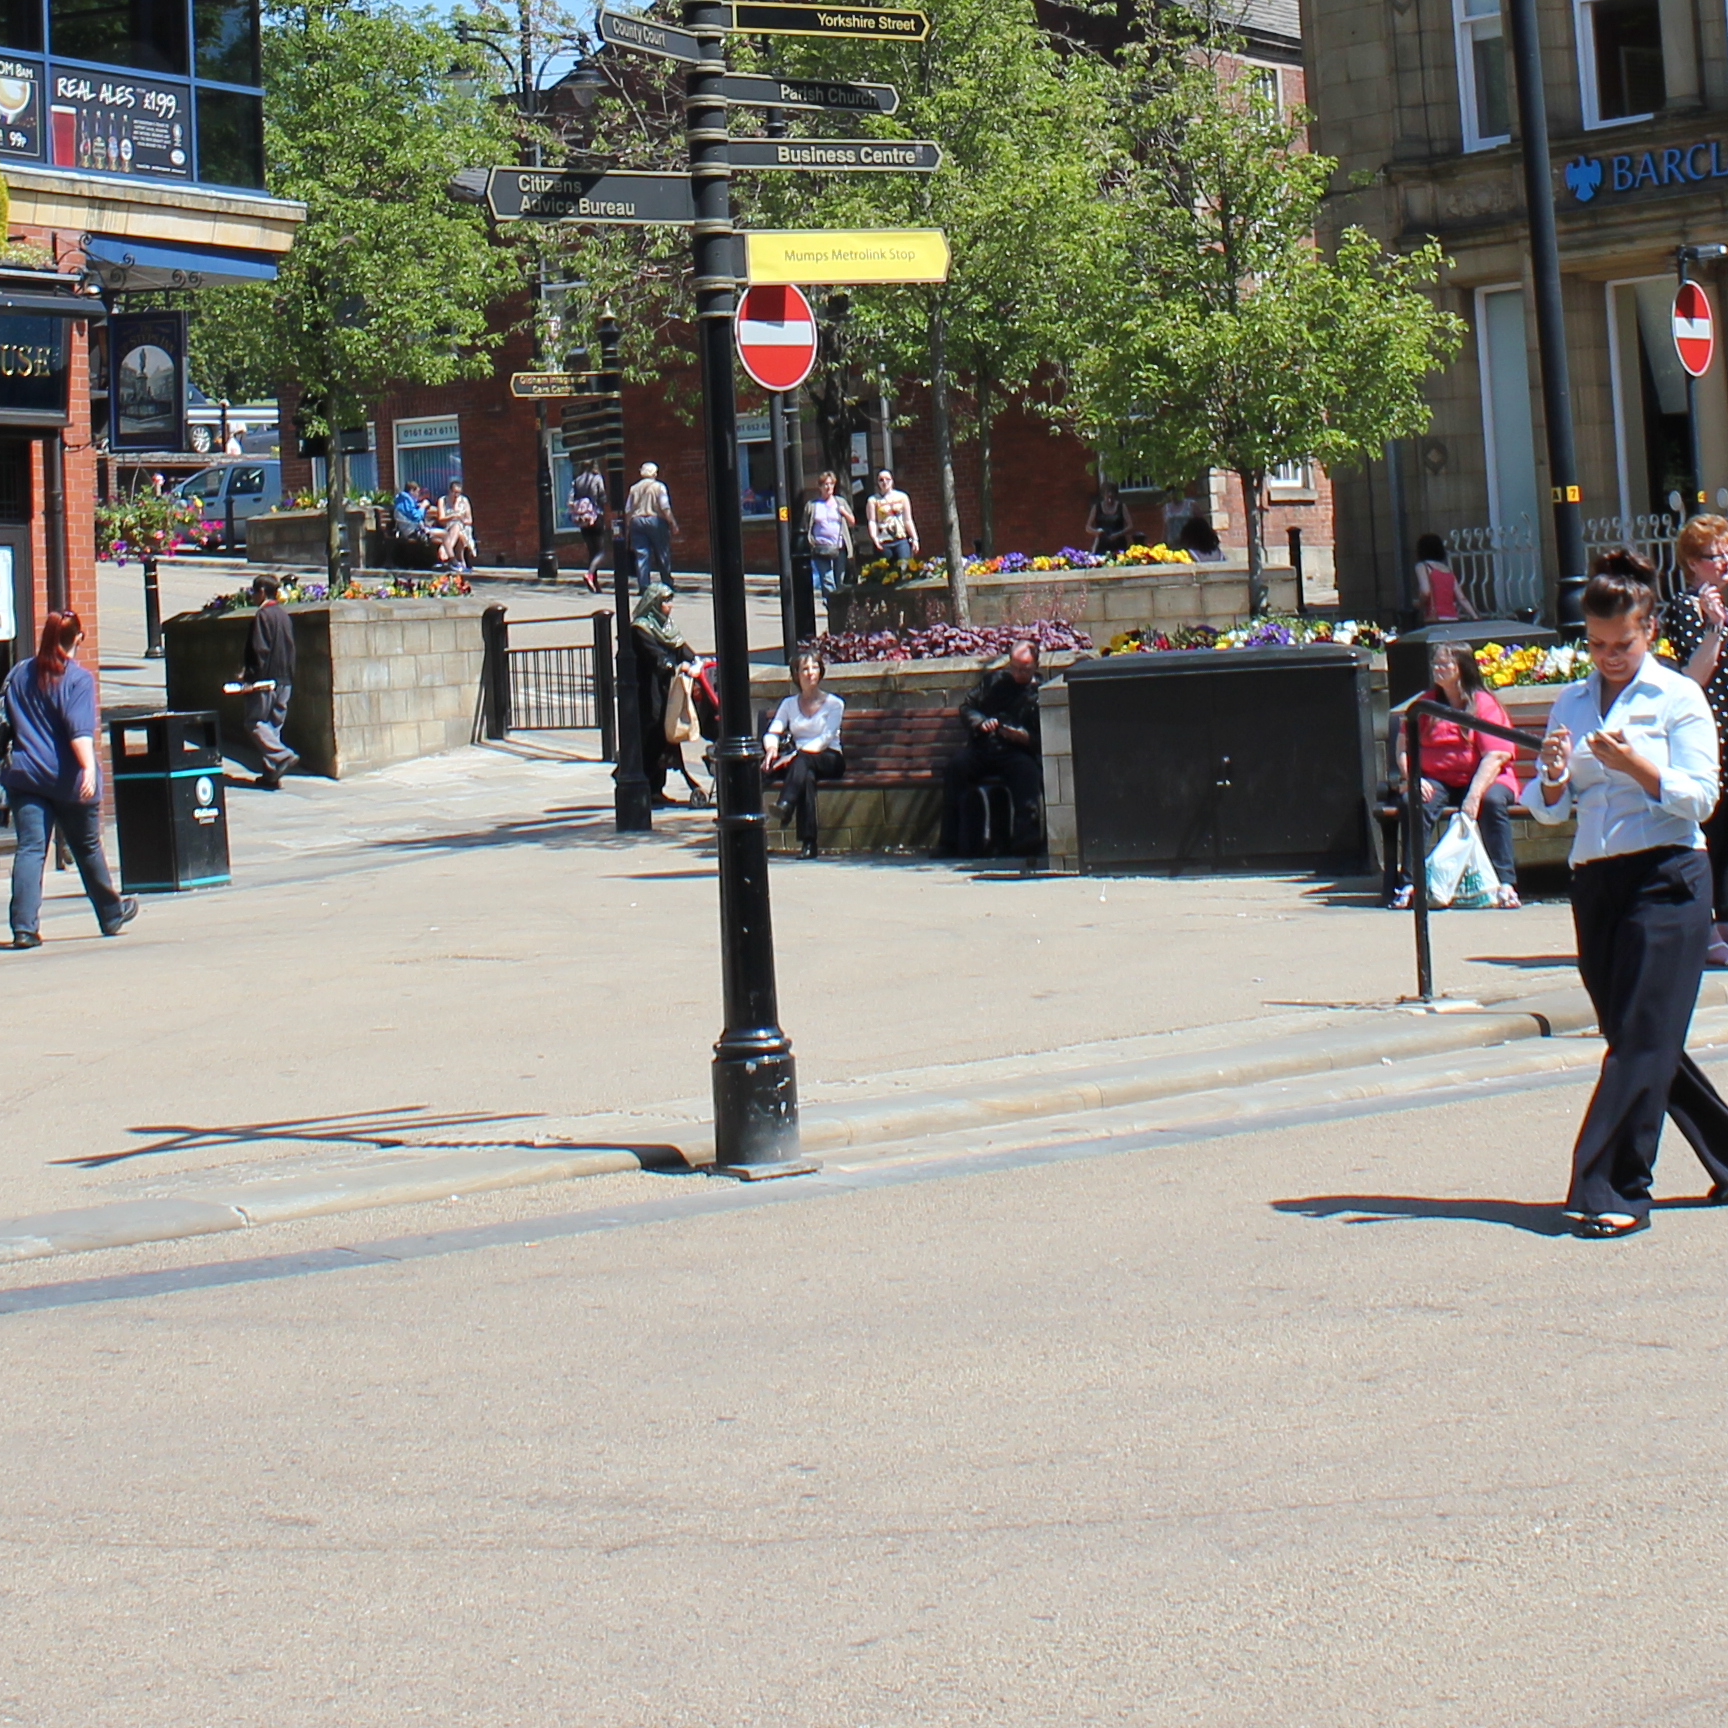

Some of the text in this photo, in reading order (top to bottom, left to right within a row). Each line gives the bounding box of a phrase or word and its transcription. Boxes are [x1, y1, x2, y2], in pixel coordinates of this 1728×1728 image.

[817, 12, 916, 31] Yorkshire Street
[613, 17, 666, 47] County Court
[15, 63, 34, 79] 8AM
[57, 76, 97, 103] REAL
[99, 82, 136, 109] ALES
[143, 90, 177, 120] £1.99
[780, 83, 878, 106] Parish Church
[777, 146, 916, 164] Business Centre
[518, 174, 583, 193] Citizens
[519, 195, 635, 216] Advice Bureau
[784, 247, 916, 263] Mumps Metrolink Stop
[404, 425, 457, 437] 0161 621 6111
